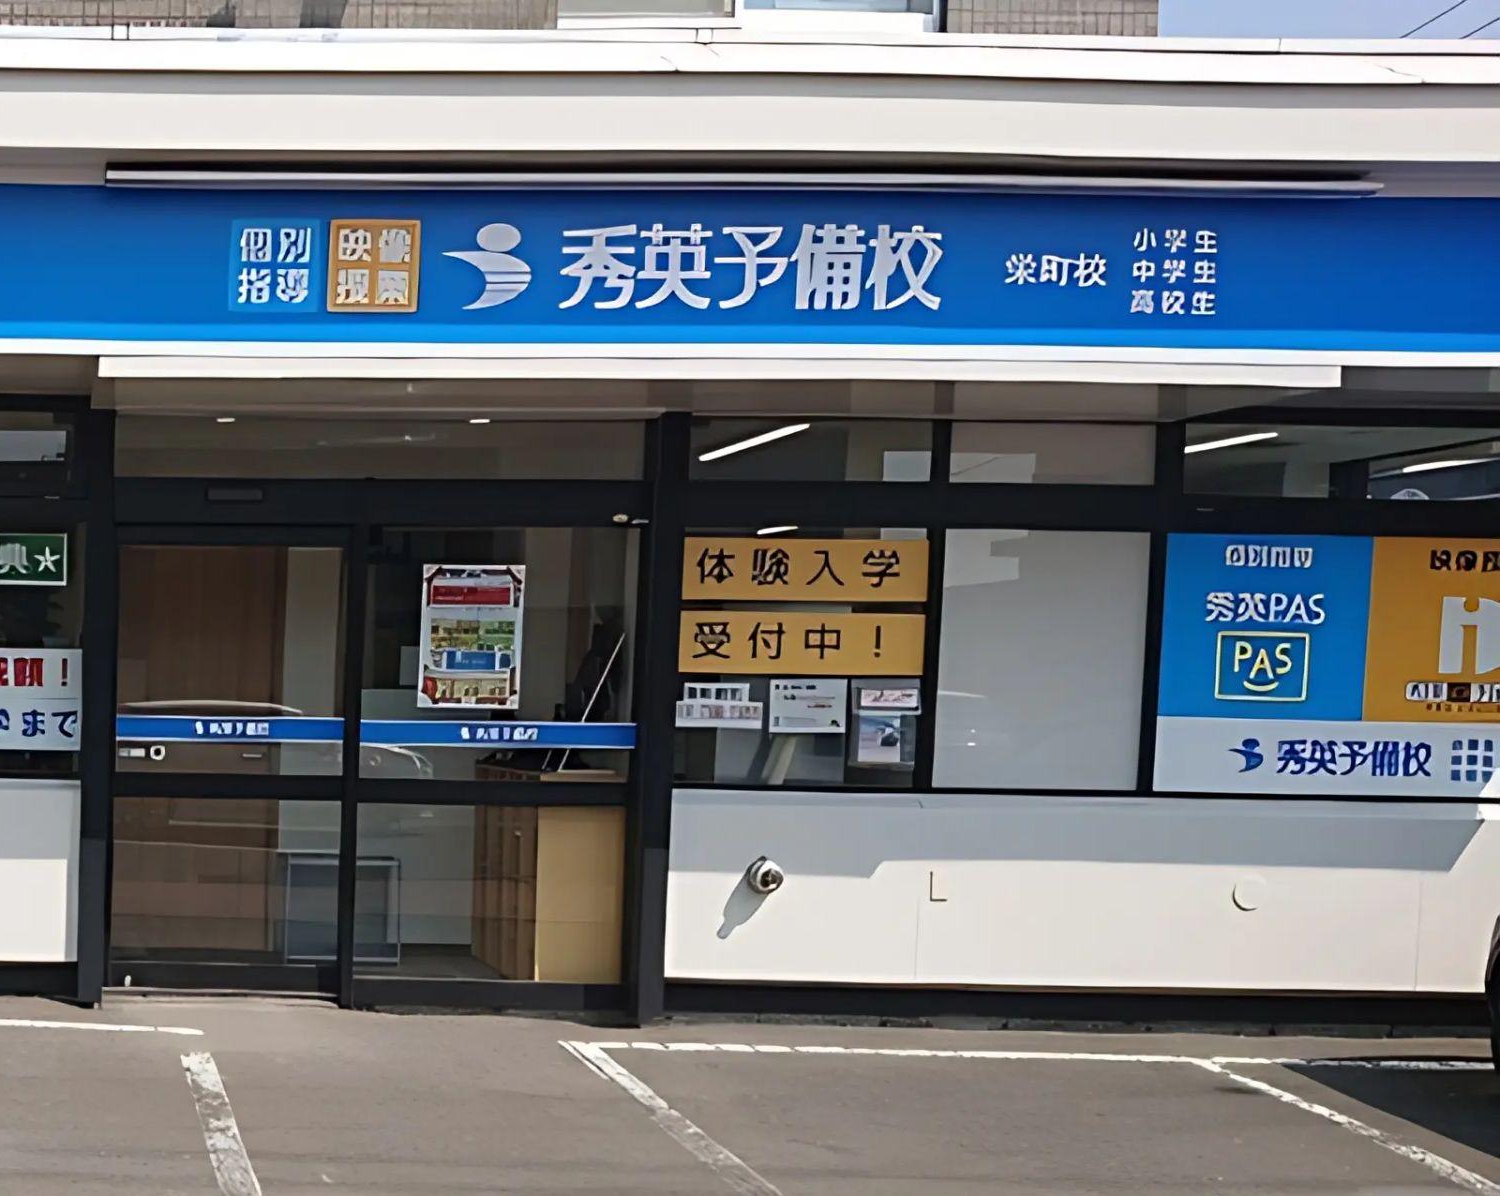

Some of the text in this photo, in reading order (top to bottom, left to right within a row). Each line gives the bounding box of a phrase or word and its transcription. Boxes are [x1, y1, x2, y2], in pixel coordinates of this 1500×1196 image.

[1133, 227, 1218, 254] 小学生
[558, 223, 943, 311] 秀英予備校
[1004, 252, 1107, 287] 栄町校
[1132, 258, 1217, 284] 中学生
[696, 547, 901, 588] 体験入学
[691, 621, 882, 660] 受付中!
[1233, 640, 1293, 680] PAS
